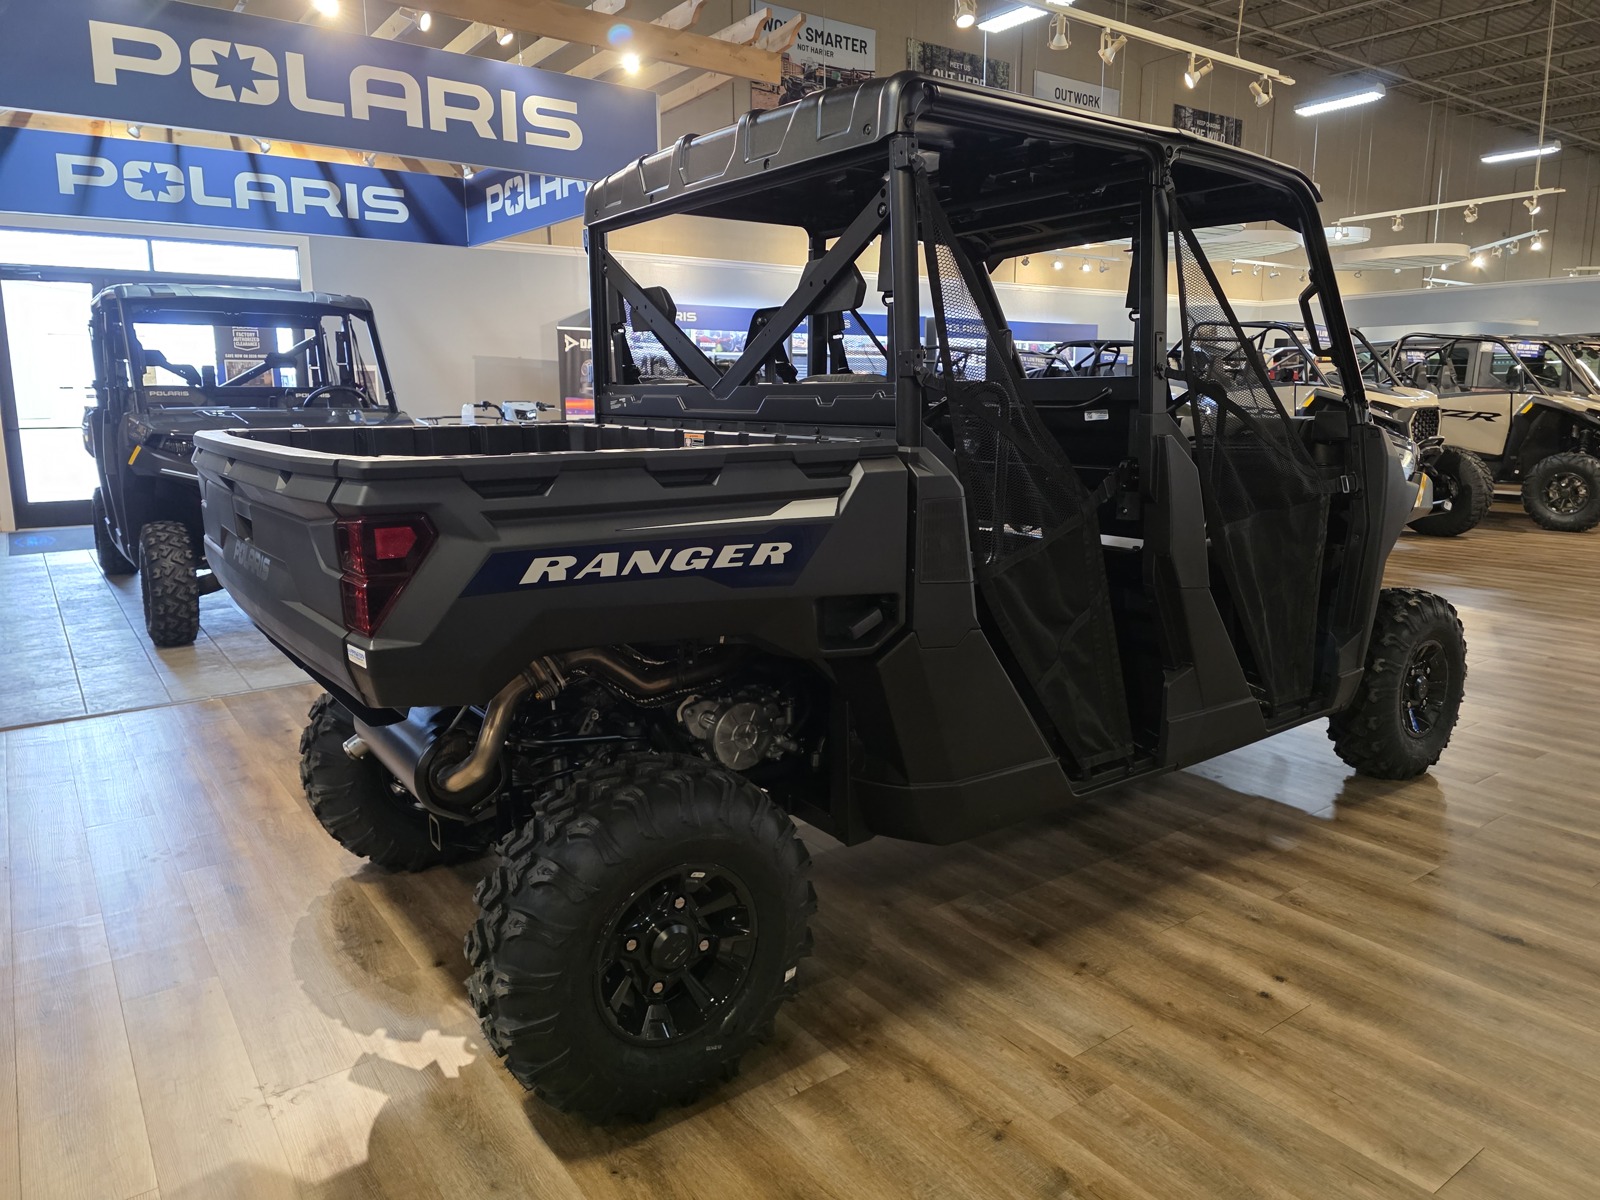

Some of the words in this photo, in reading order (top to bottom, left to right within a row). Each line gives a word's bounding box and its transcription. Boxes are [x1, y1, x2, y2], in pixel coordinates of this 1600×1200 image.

[797, 43, 809, 53] NOT
[811, 48, 834, 58] HARDER
[805, 27, 868, 54] SMARTER
[950, 61, 964, 69] MEET
[89, 20, 584, 151] POLARIS
[1055, 87, 1101, 109] OUTWORK
[55, 153, 410, 224] POLARIS
[486, 172, 594, 223] POLAR
[1442, 408, 1502, 422] ZR
[233, 540, 271, 581] POLARIS
[518, 541, 793, 585] RANGER
